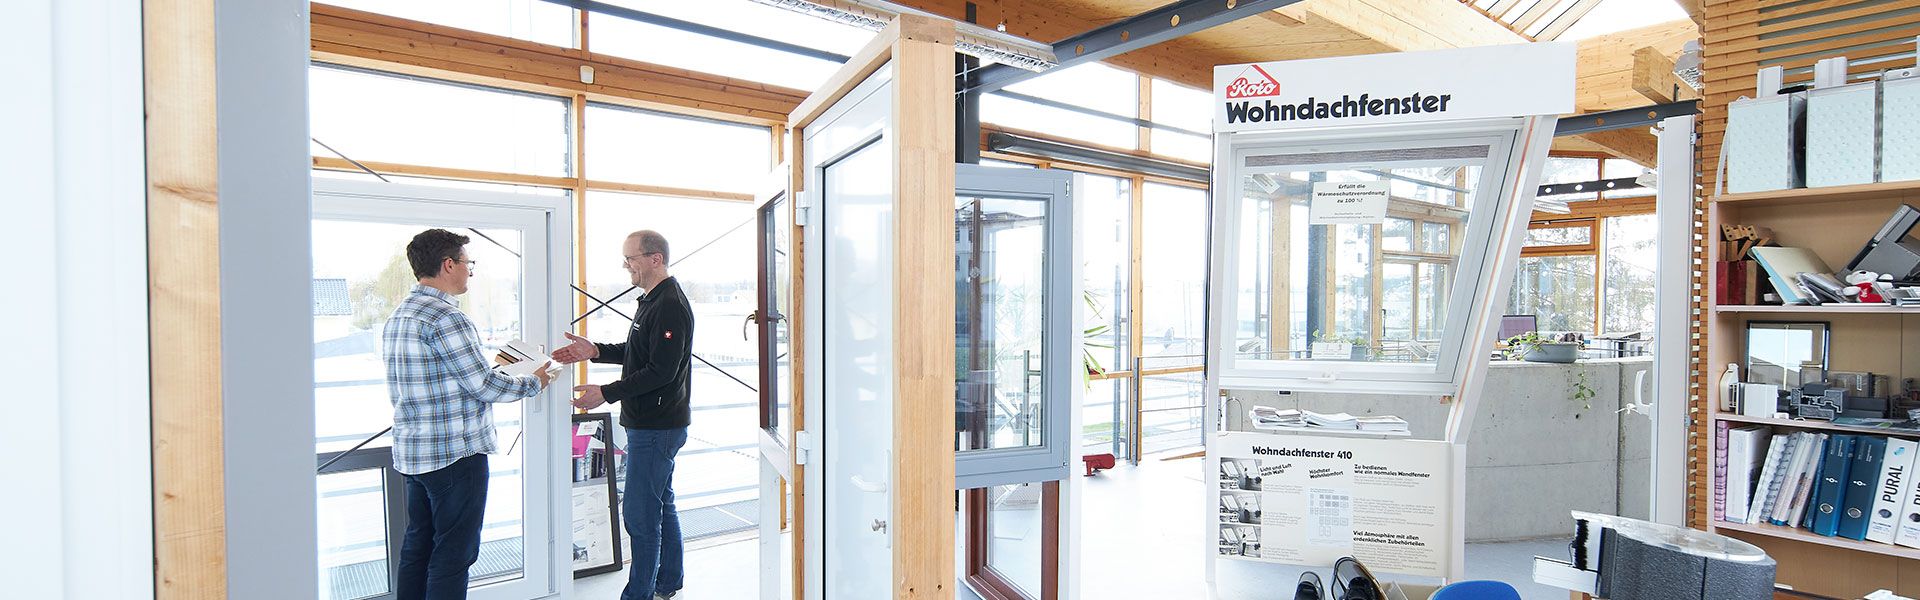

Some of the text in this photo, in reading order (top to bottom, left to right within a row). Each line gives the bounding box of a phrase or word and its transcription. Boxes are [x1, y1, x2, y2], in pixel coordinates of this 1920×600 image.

[1229, 77, 1278, 97] Roto
[1226, 91, 1451, 124] Wohndachfenster
[1252, 446, 1353, 460] Wohndachfenster 410
[1882, 466, 1903, 503] PURAL
